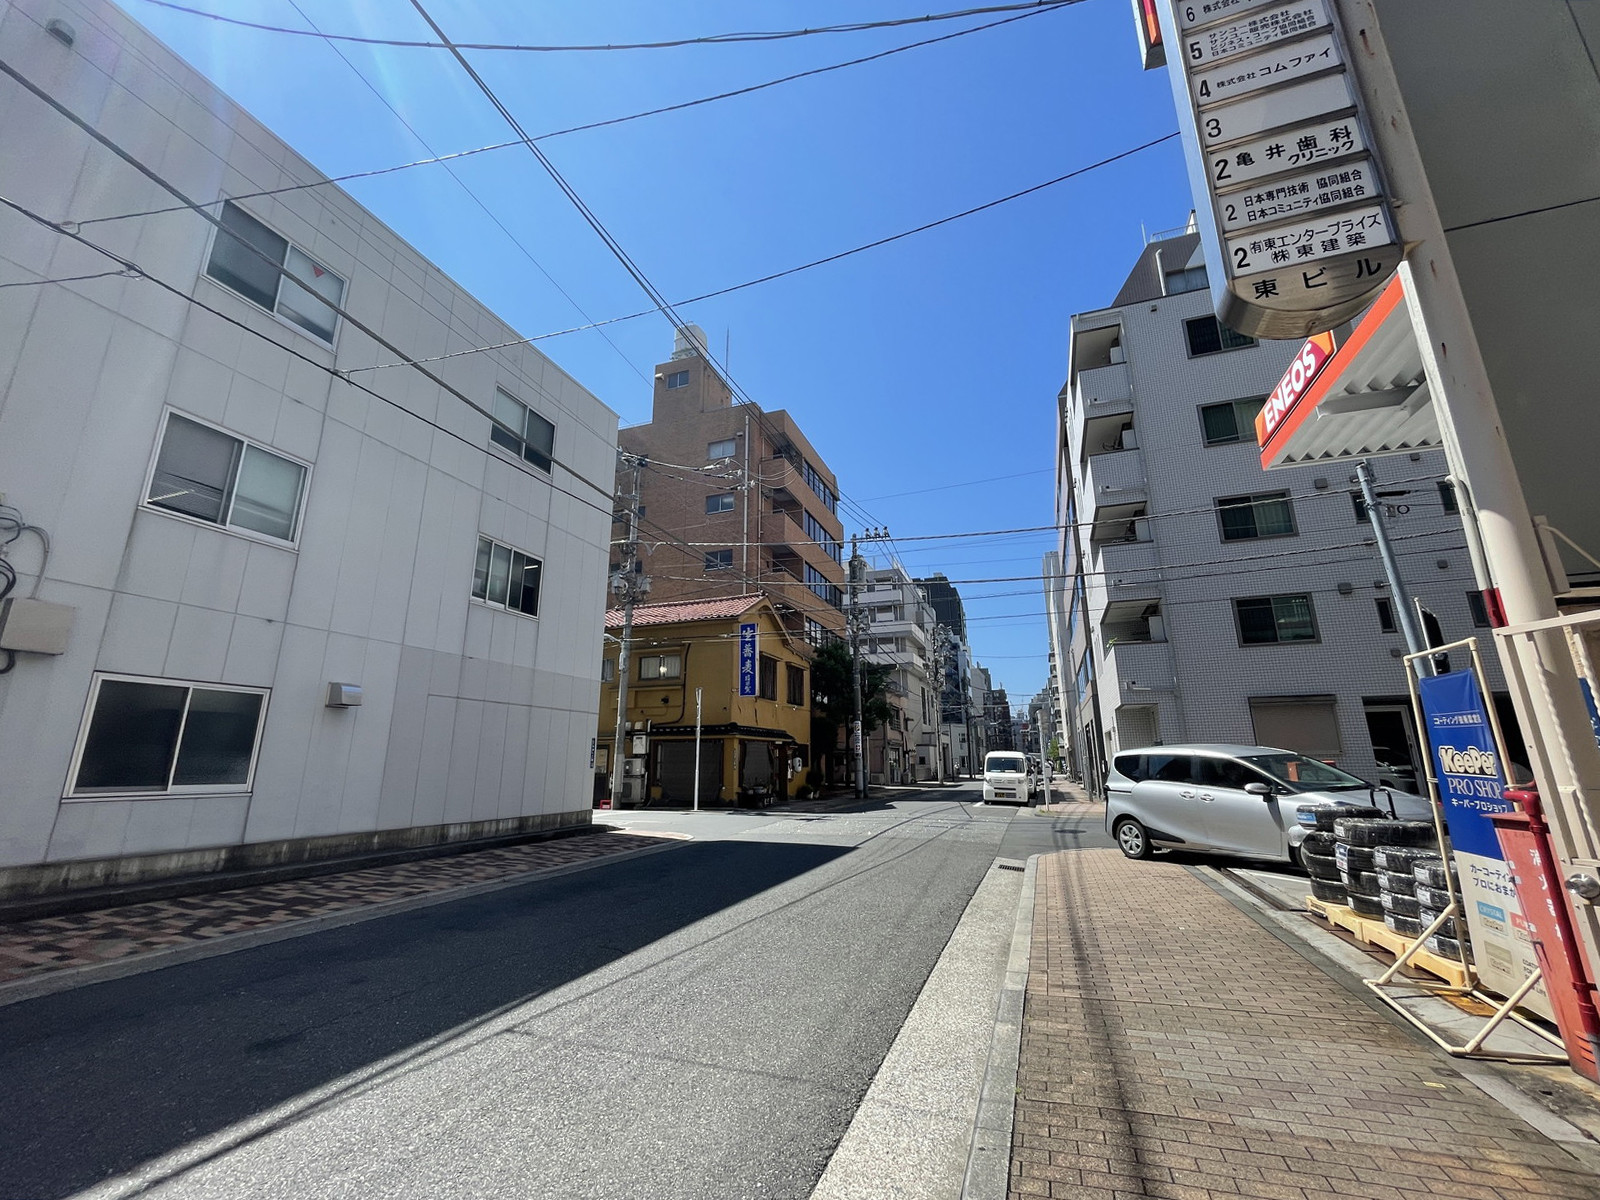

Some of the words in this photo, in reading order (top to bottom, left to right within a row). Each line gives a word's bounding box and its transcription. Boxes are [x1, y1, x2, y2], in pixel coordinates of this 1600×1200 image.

[1186, 6, 1196, 22] 6
[1189, 41, 1203, 60] 5
[1199, 79, 1211, 98] 4
[1216, 71, 1257, 89] 株式会社
[1259, 47, 1331, 77] コムファイ
[1206, 118, 1222, 138] 3
[1214, 158, 1232, 182] 2
[1236, 125, 1352, 167] 亀井歯科
[1287, 139, 1355, 165] クリニック
[1225, 204, 1238, 222] 2
[1247, 184, 1366, 222] 日本コミュニティ協同組合
[1233, 247, 1250, 269] 2
[1252, 257, 1382, 300] 東ビル
[1263, 342, 1316, 434] ENEOS
[1439, 746, 1498, 777] KeePer
[1448, 777, 1474, 796] PRO
[1474, 779, 1502, 800] SHOP
